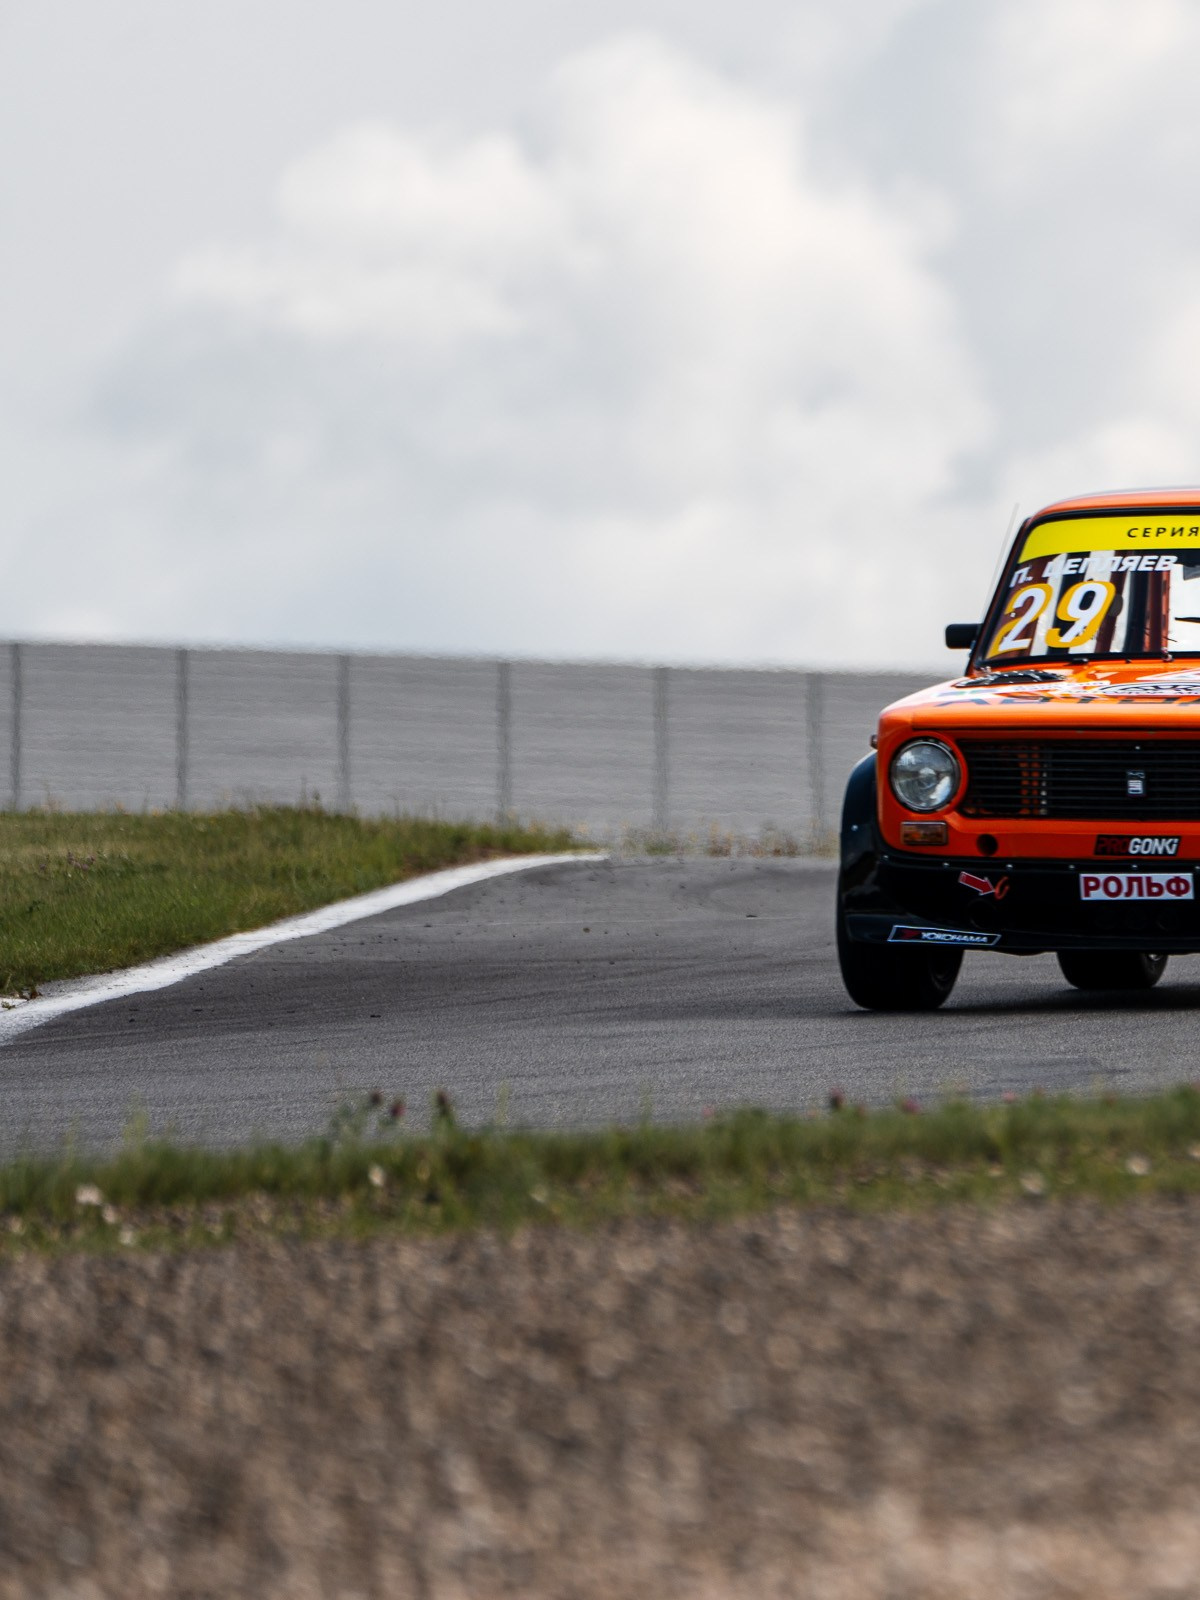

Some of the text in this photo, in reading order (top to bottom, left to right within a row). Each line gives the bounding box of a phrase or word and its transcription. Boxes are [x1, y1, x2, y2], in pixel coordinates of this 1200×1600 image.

[1127, 526, 1200, 538] СЕРИЯ
[988, 580, 1116, 658] 29
[1082, 875, 1191, 899] РОЛЬФ
[921, 931, 988, 943] YOKOHAMA
